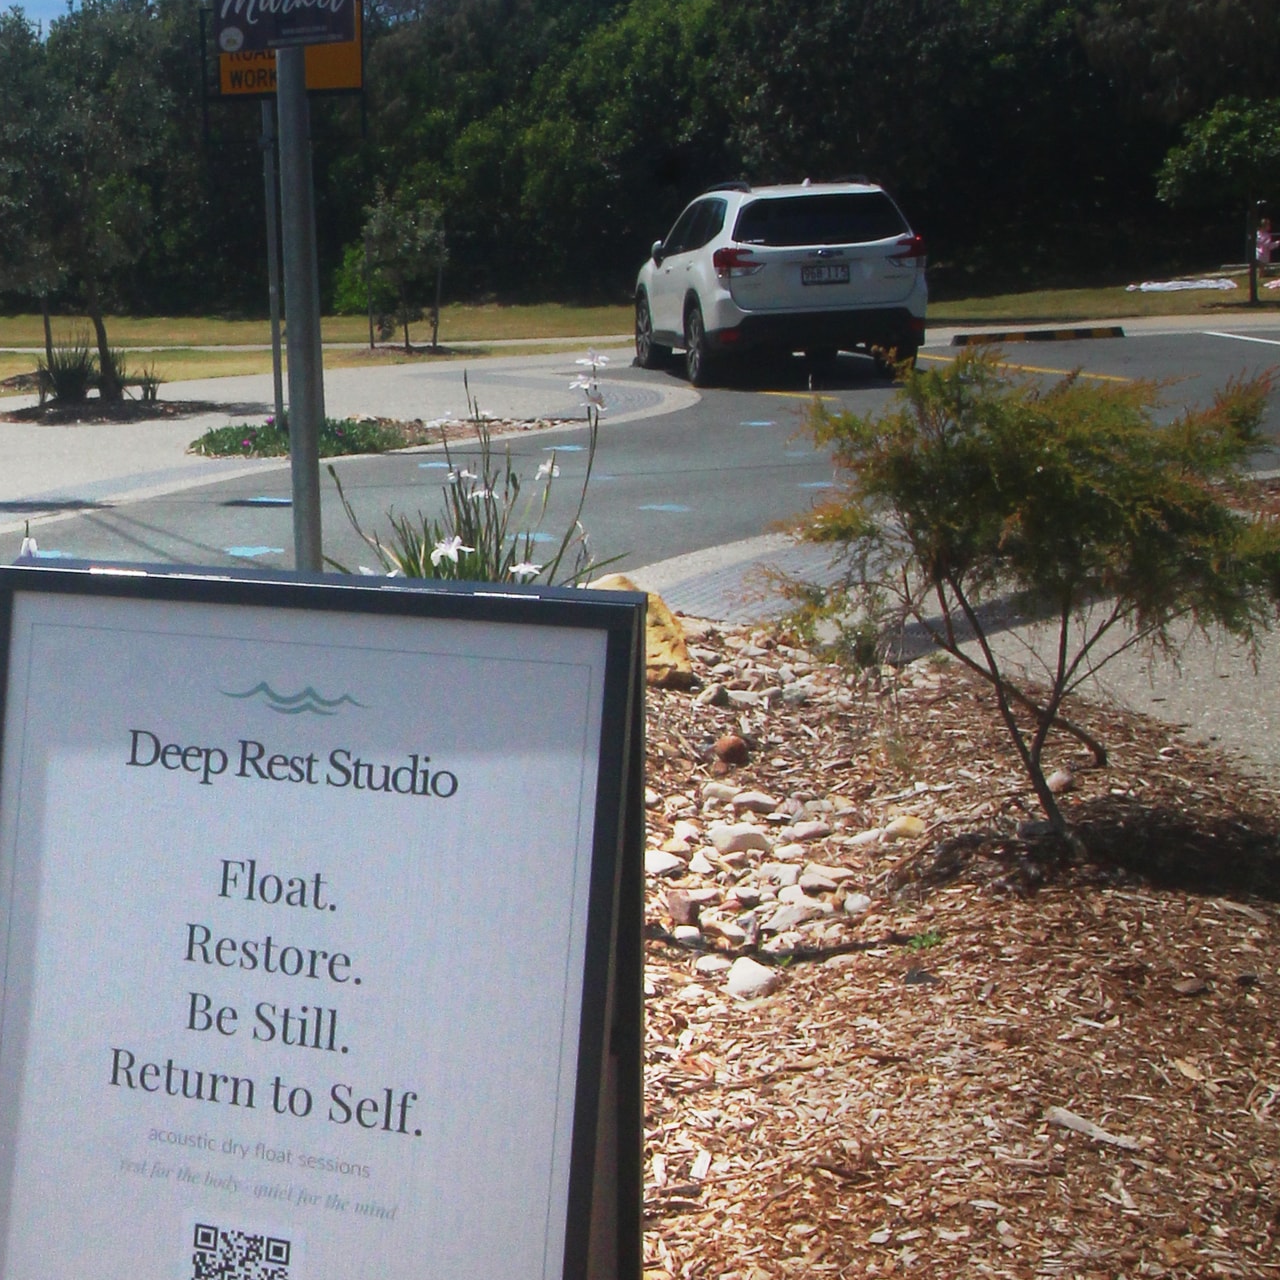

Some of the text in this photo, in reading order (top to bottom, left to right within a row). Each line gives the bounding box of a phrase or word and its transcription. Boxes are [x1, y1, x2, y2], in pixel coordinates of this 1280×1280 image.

[126, 728, 459, 799] Deep Rest Studio
[218, 858, 337, 912] Float.
[183, 923, 362, 985] Restore.
[187, 992, 349, 1054] Be Still.
[108, 1047, 423, 1137] Return to Self.
[148, 1125, 370, 1178] acoustic dry float sessions
[149, 1160, 174, 1179] for
[176, 1163, 201, 1184] the
[204, 1170, 240, 1193] body
[253, 1182, 294, 1202] quiet
[296, 1187, 321, 1206] for
[324, 1192, 351, 1211] the
[355, 1197, 399, 1221] mind
